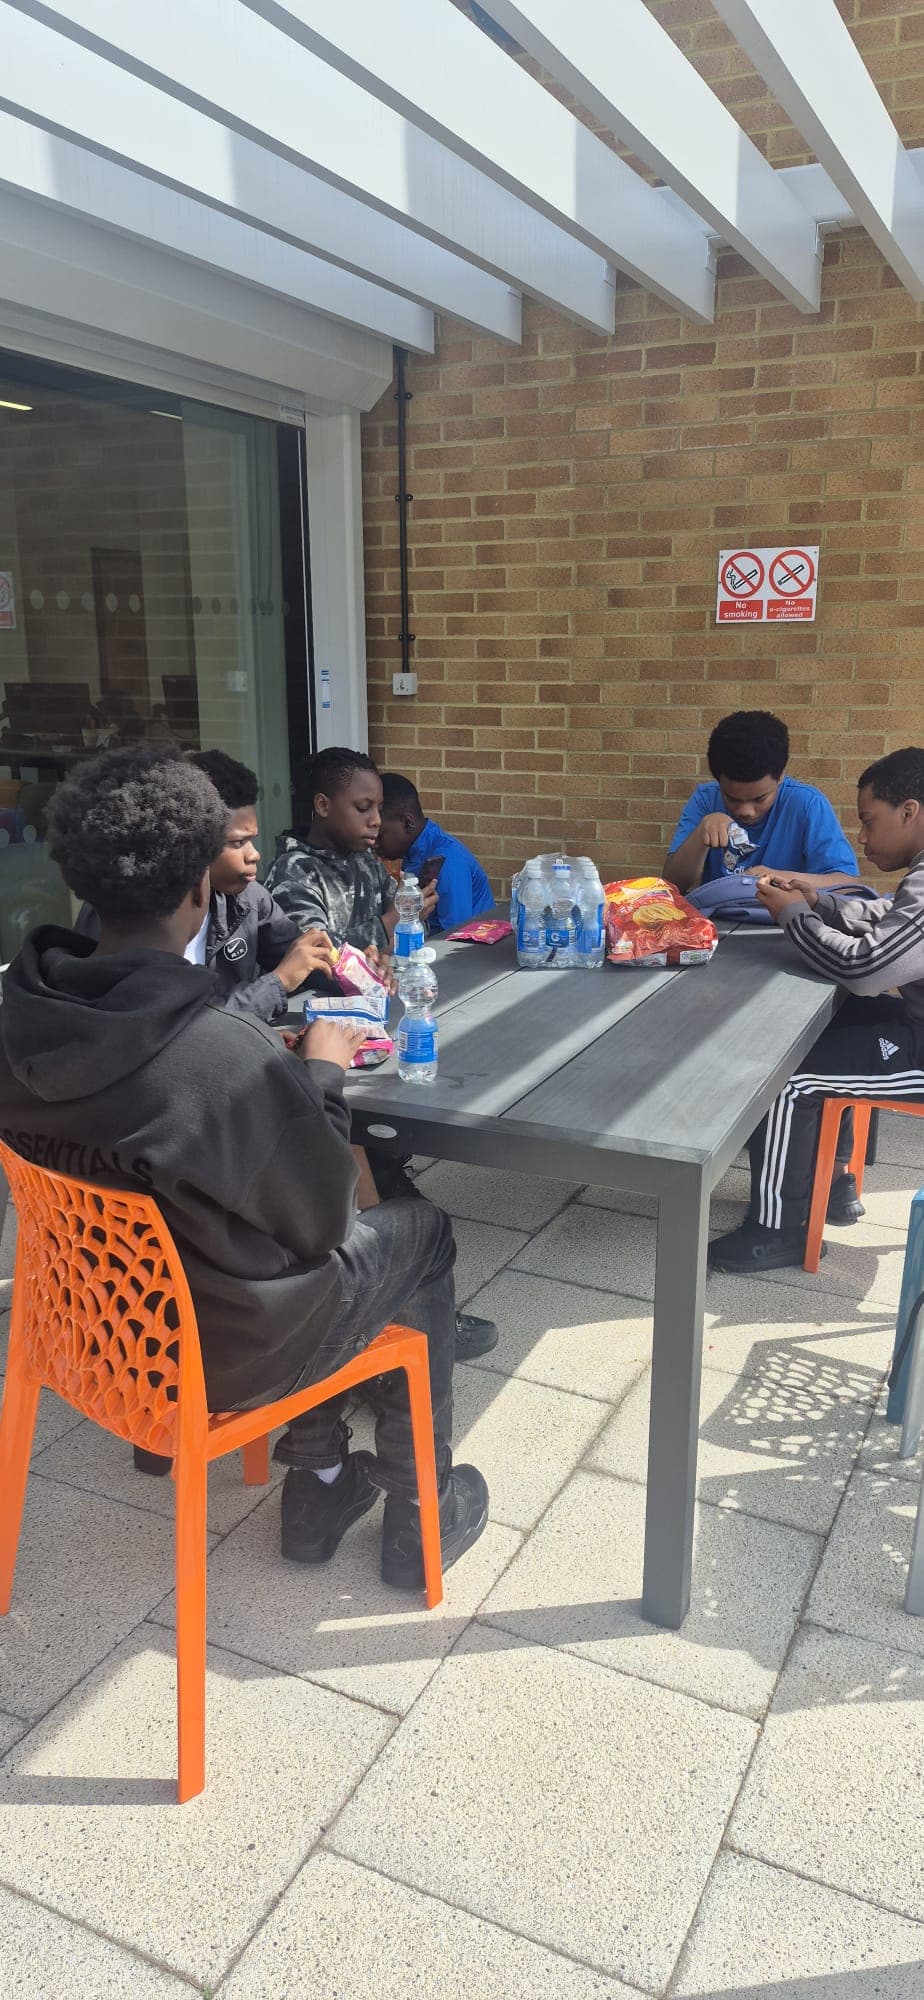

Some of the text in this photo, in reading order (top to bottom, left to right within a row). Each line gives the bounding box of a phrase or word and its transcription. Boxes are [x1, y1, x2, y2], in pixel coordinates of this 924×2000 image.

[735, 601, 747, 609] No
[723, 610, 758, 619] smoking
[879, 1037, 890, 1060] adidas
